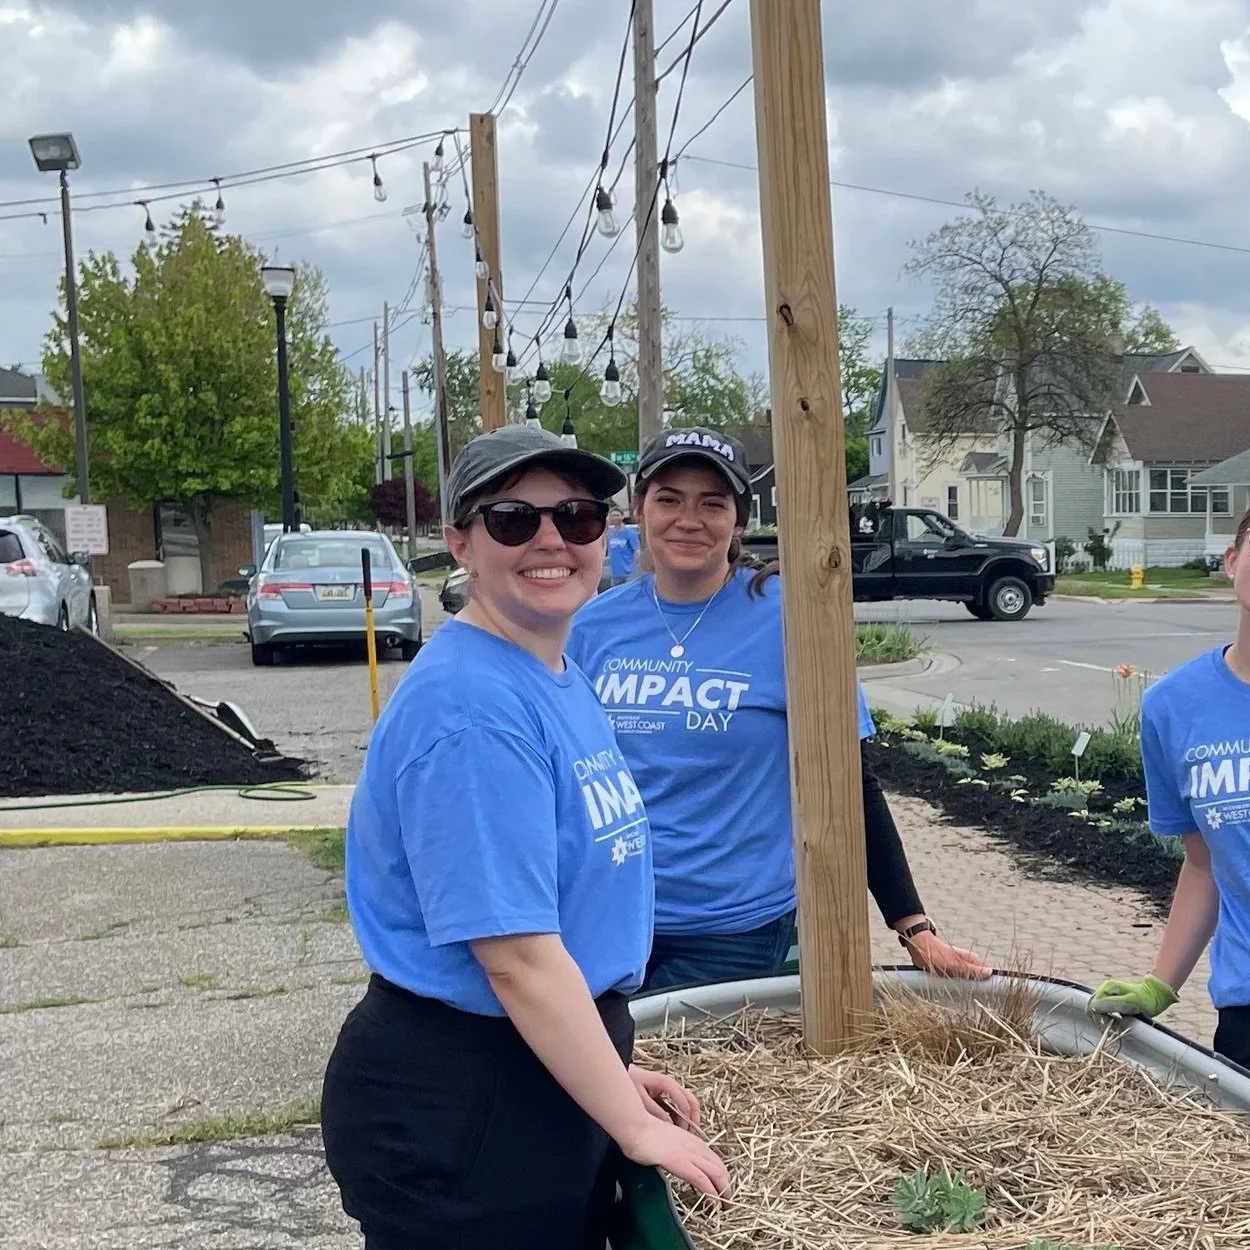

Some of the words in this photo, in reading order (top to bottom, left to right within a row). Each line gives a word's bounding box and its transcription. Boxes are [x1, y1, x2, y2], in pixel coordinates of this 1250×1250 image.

[665, 432, 735, 461] MAMA
[603, 658, 693, 673] COMMUNITY
[616, 720, 638, 729] WEST
[638, 720, 665, 731] COAST
[686, 711, 735, 731] DAY
[1223, 809, 1247, 820] WEST
